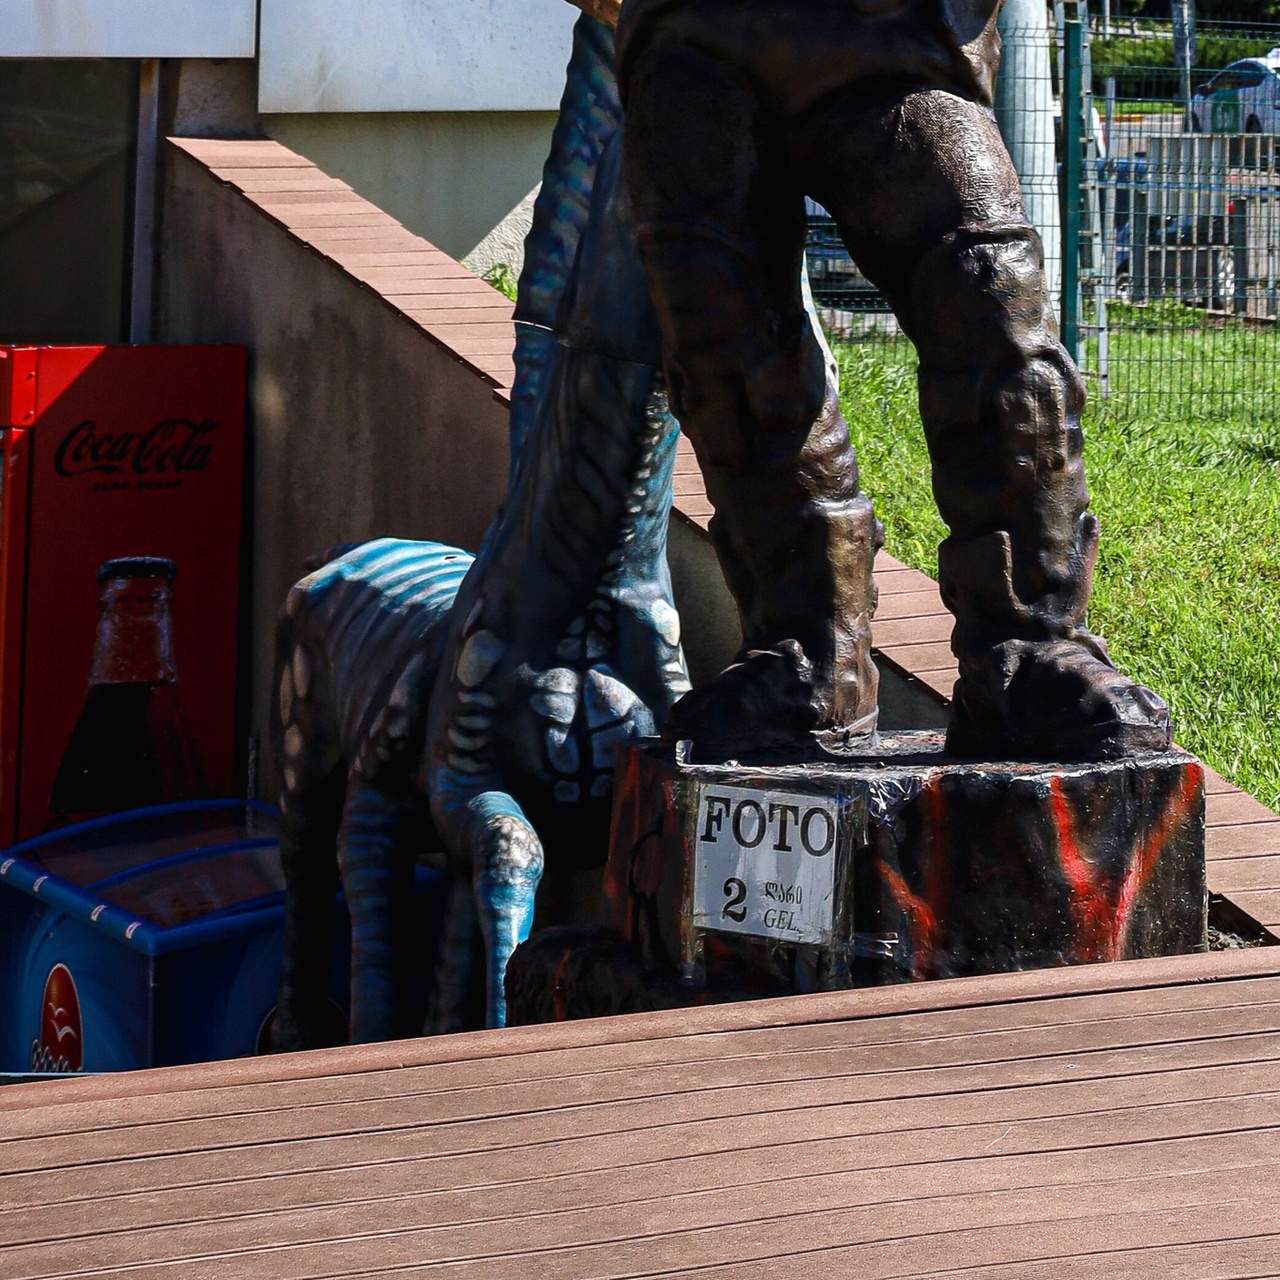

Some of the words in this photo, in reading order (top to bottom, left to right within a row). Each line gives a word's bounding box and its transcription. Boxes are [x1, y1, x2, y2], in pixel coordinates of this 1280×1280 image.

[54, 418, 222, 476] Coca-Cola
[94, 481, 130, 491] ZERO
[135, 479, 184, 490] SUGAR
[700, 795, 835, 857] FOTO
[721, 877, 748, 923] 2
